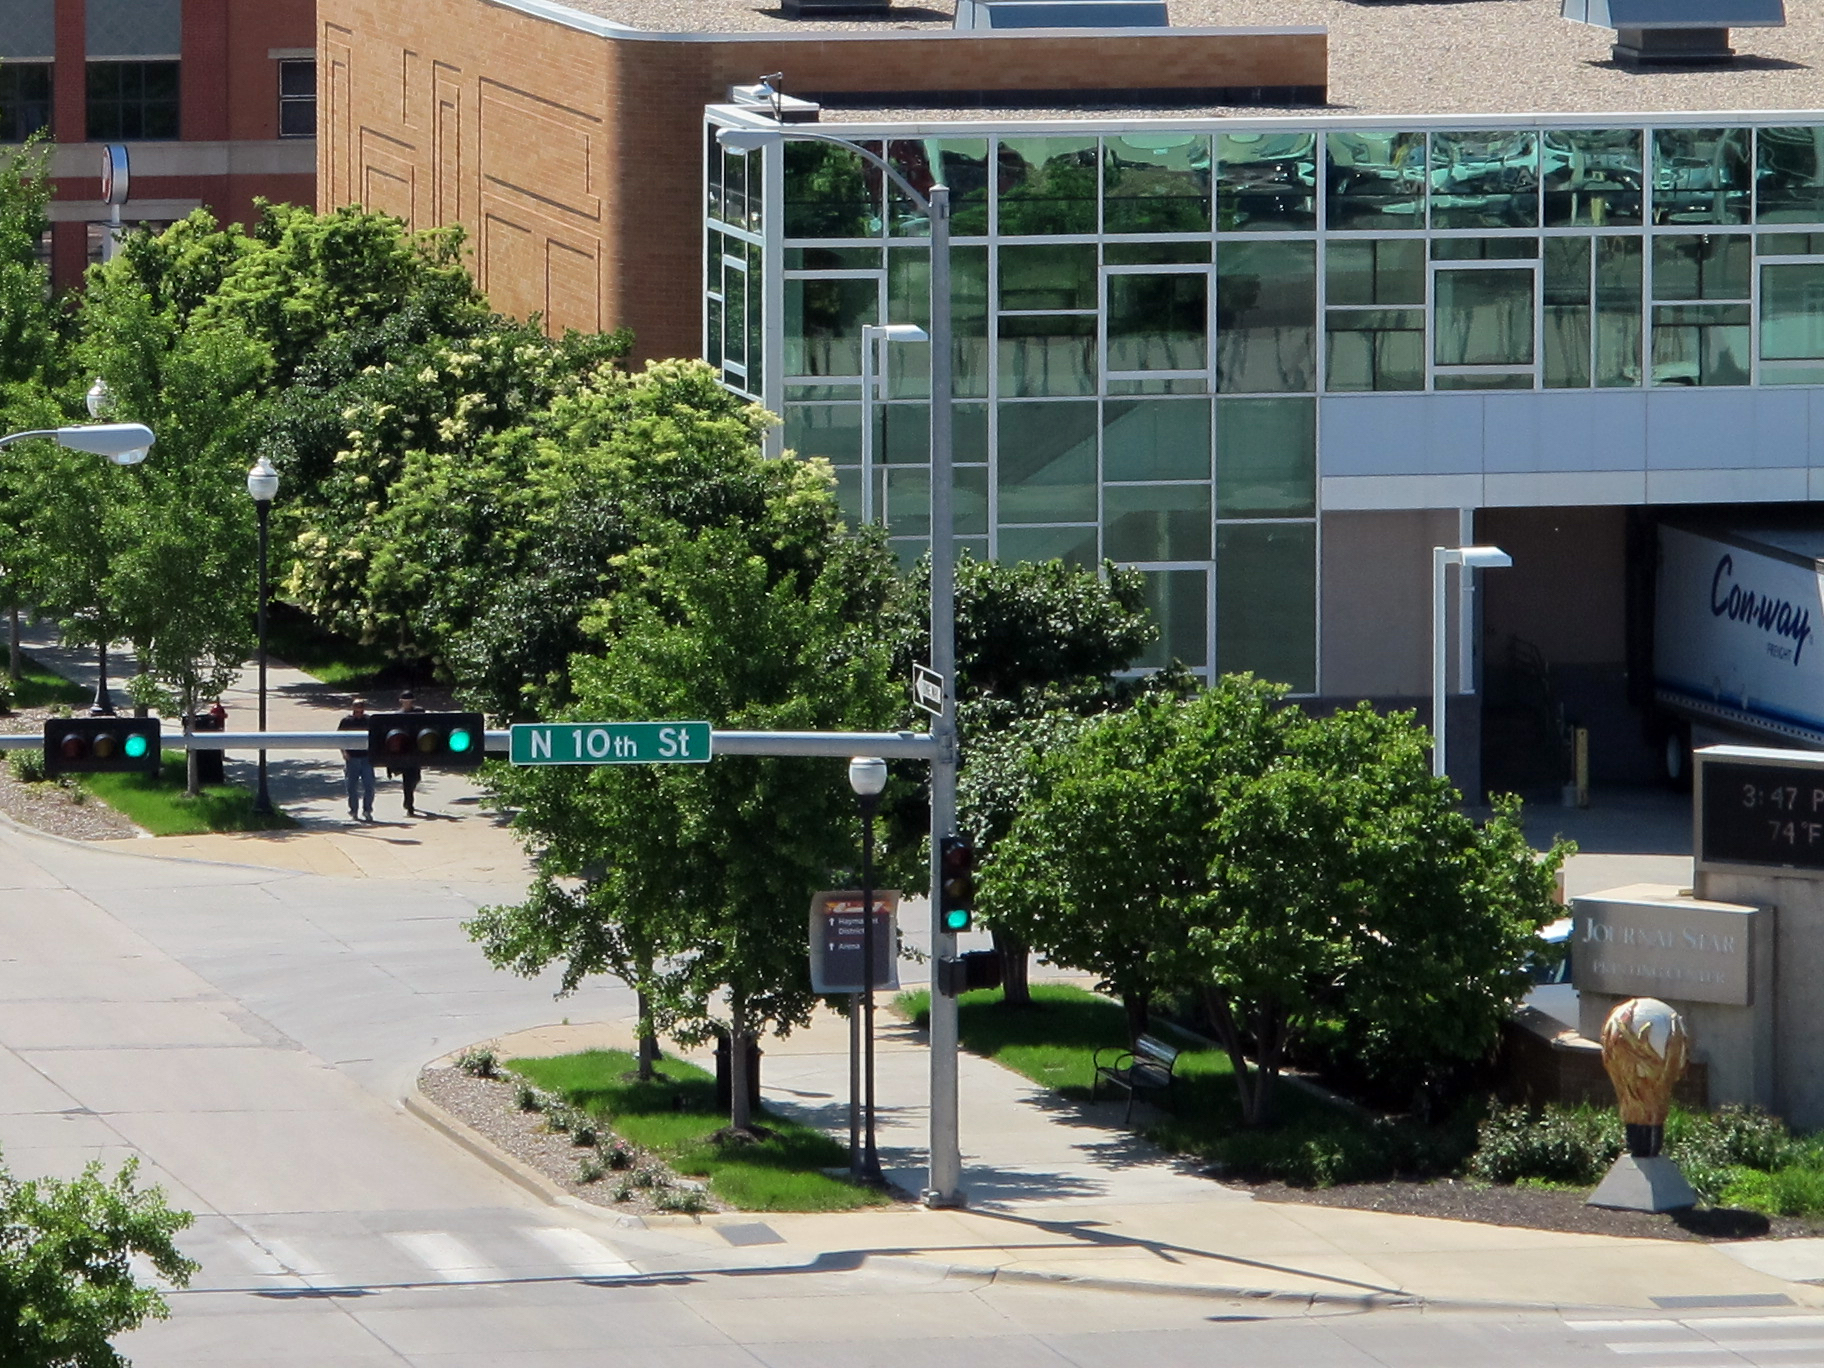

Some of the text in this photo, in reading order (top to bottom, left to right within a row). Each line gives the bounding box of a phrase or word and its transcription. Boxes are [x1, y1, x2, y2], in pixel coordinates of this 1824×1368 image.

[531, 727, 690, 758] N 10th St
[1742, 784, 1797, 810] 3:47
